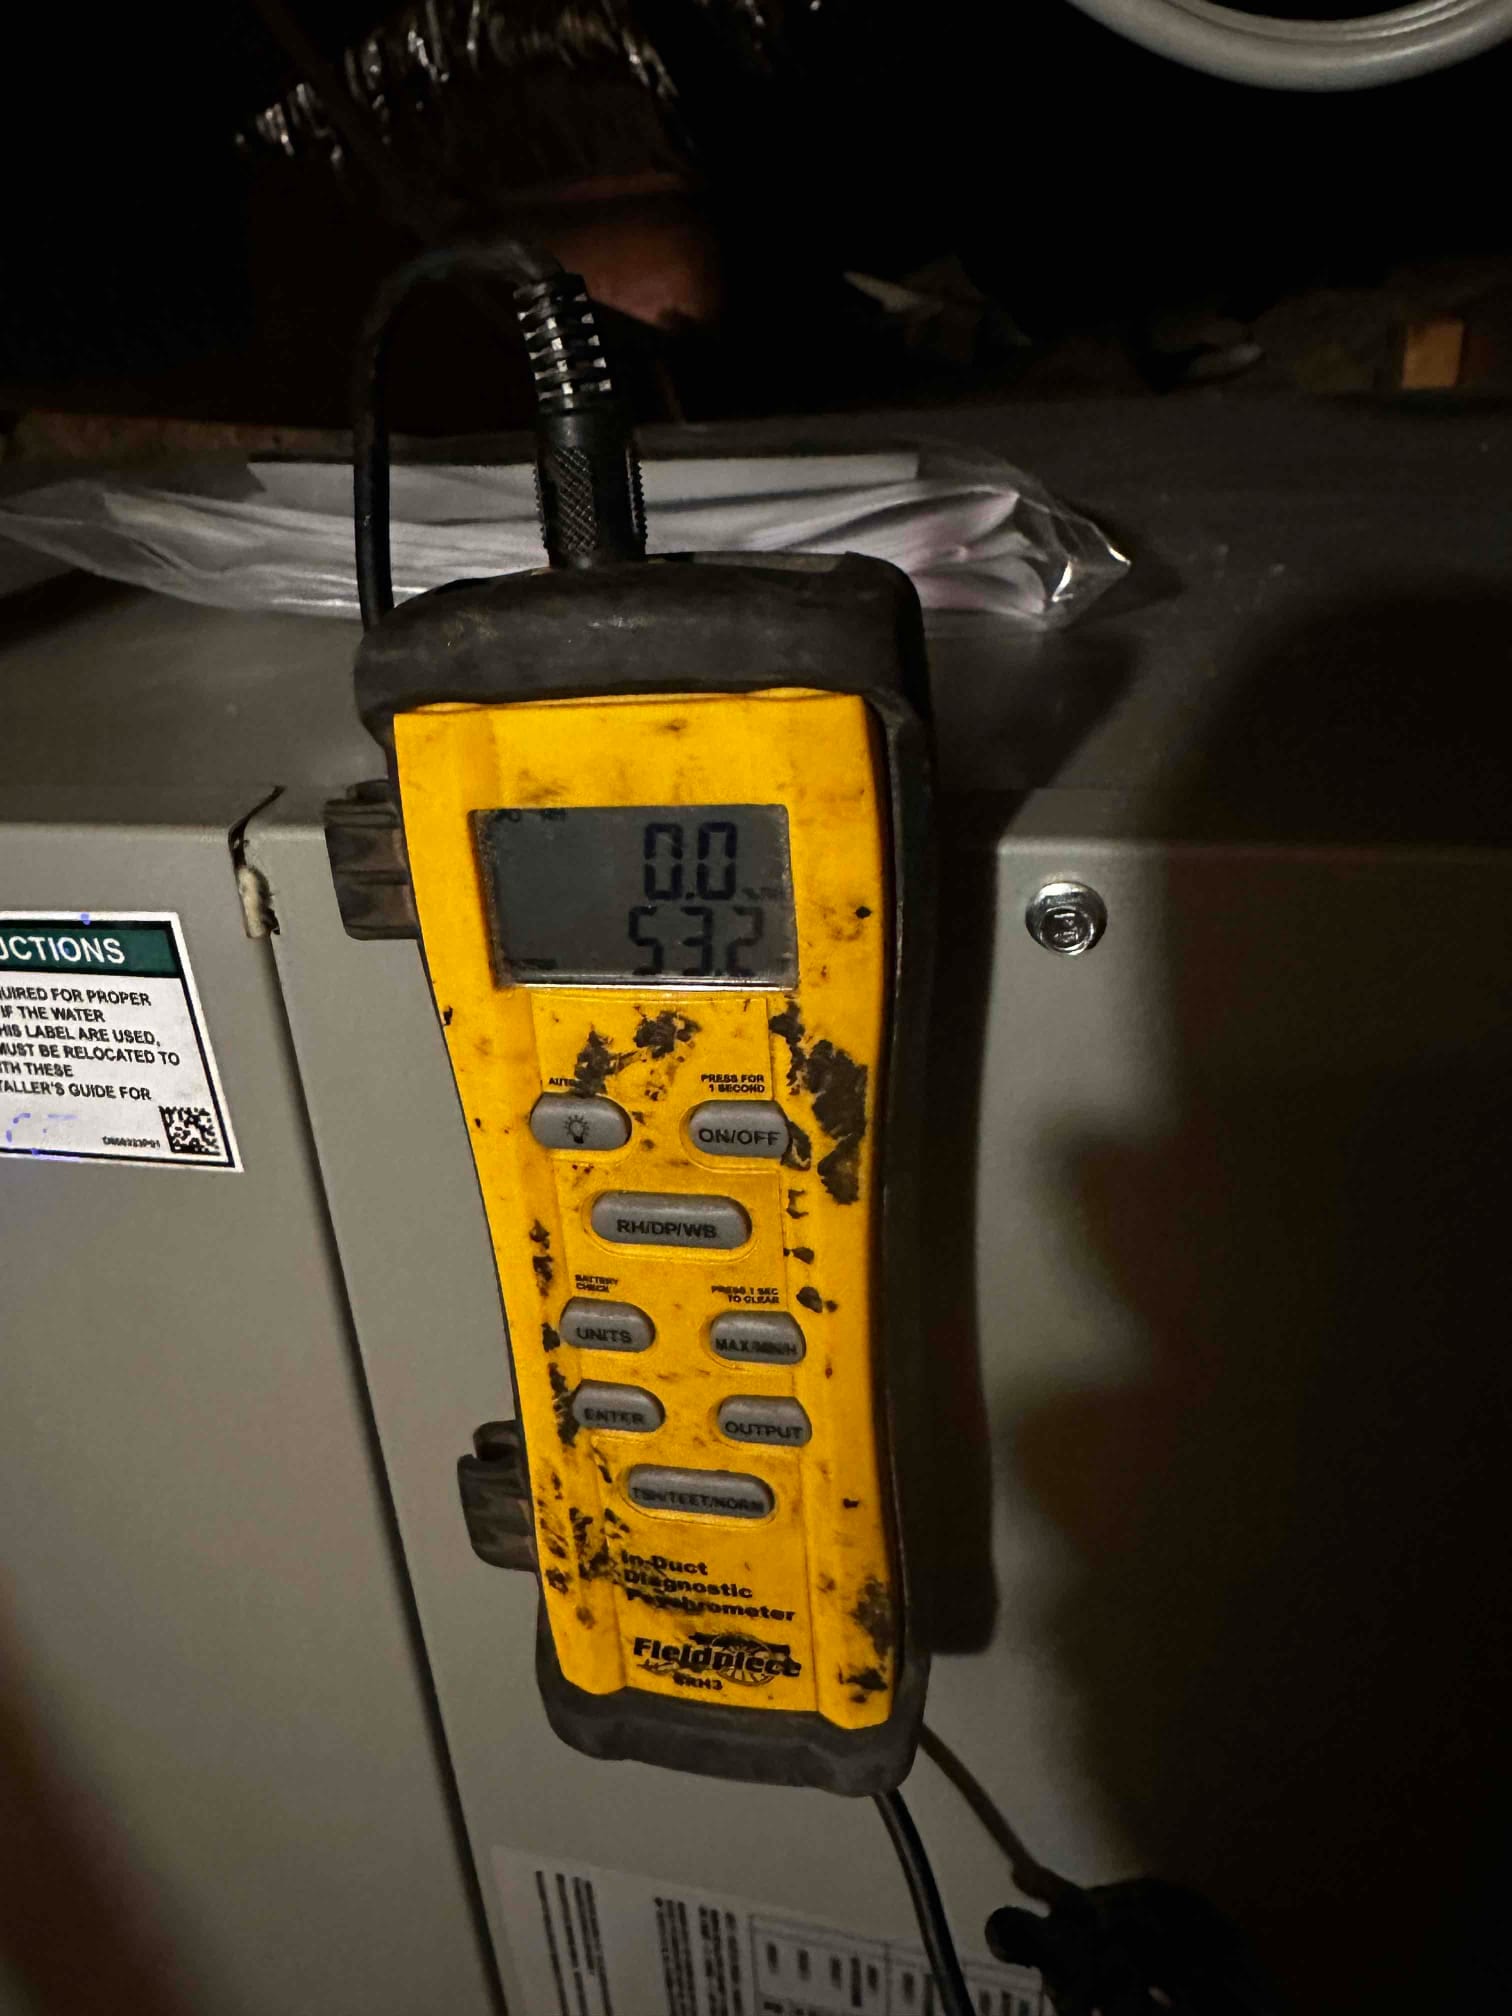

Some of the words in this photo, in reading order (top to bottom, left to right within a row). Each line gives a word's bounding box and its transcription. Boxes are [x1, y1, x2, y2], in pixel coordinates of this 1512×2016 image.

[643, 822, 738, 900] 0.0
[0, 986, 47, 1001] UIRED
[52, 988, 84, 1003] FOR
[88, 990, 151, 1006] PROPER
[1, 1008, 13, 1019] IF
[18, 1006, 49, 1020] THE
[51, 1008, 105, 1022] WATER
[25, 1026, 75, 1041] LABEL
[79, 1029, 109, 1042] ARE
[113, 1031, 160, 1047] USED,
[0, 1044, 34, 1057] MUST
[40, 1046, 60, 1058] BE
[64, 1047, 155, 1064] RELOCATED
[158, 1052, 180, 1065] TO
[24, 1063, 73, 1077] THESE
[701, 1074, 738, 1084] PRESS
[741, 1075, 764, 1084] FOR
[69, 1083, 115, 1098] GUIDE
[120, 1087, 151, 1101] FOR
[718, 1084, 765, 1093] SECOND
[698, 1128, 781, 1147] ON/OFF
[617, 1218, 717, 1239] RH/DP/WB
[711, 1286, 746, 1296] PRESS
[756, 1287, 779, 1296] SEC
[728, 1294, 743, 1303] TO
[745, 1295, 780, 1304] CLEAR
[575, 1327, 632, 1343] UNITS
[583, 1407, 646, 1425] ENTER
[725, 1421, 803, 1440] OUTPUT
[621, 1550, 708, 1575] In-Duct
[624, 1569, 752, 1598] Diagnostic
